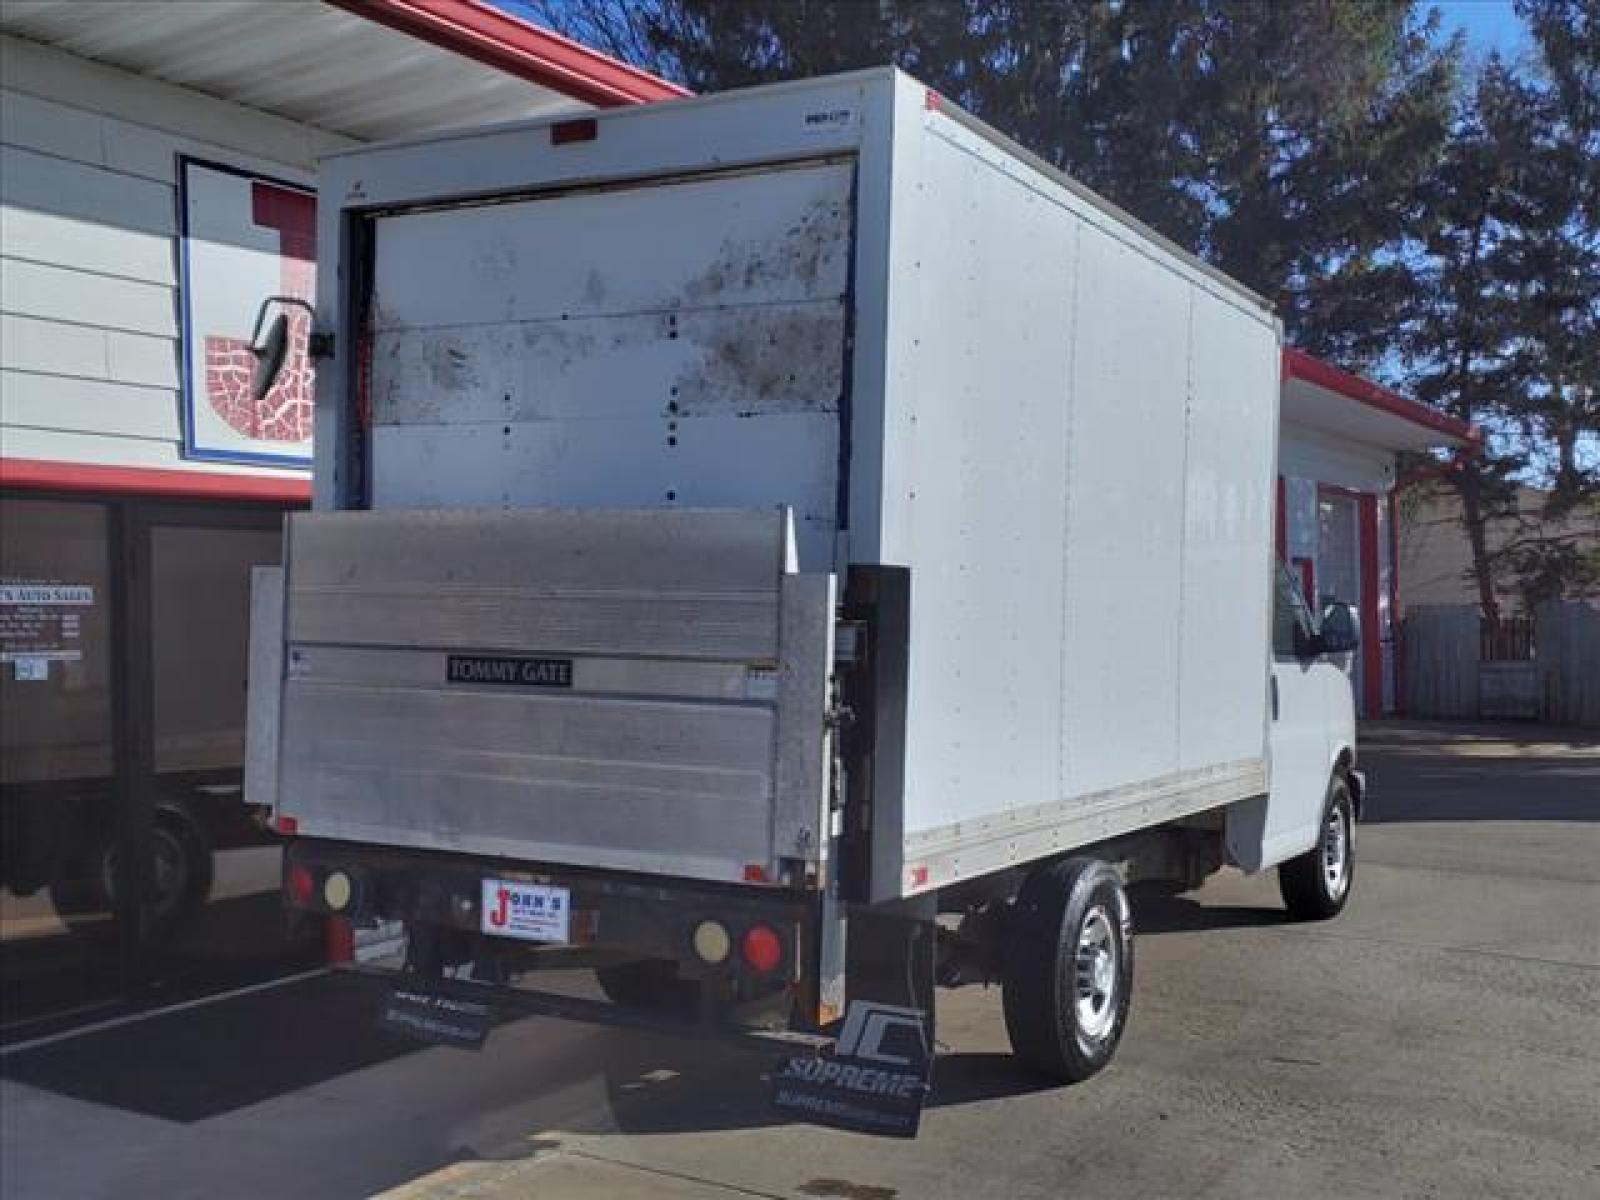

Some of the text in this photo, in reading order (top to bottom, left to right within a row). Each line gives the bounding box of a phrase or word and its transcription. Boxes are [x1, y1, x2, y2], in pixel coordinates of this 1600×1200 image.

[450, 659, 571, 685] TOMMY GATE
[783, 1056, 921, 1099] SUPREME
